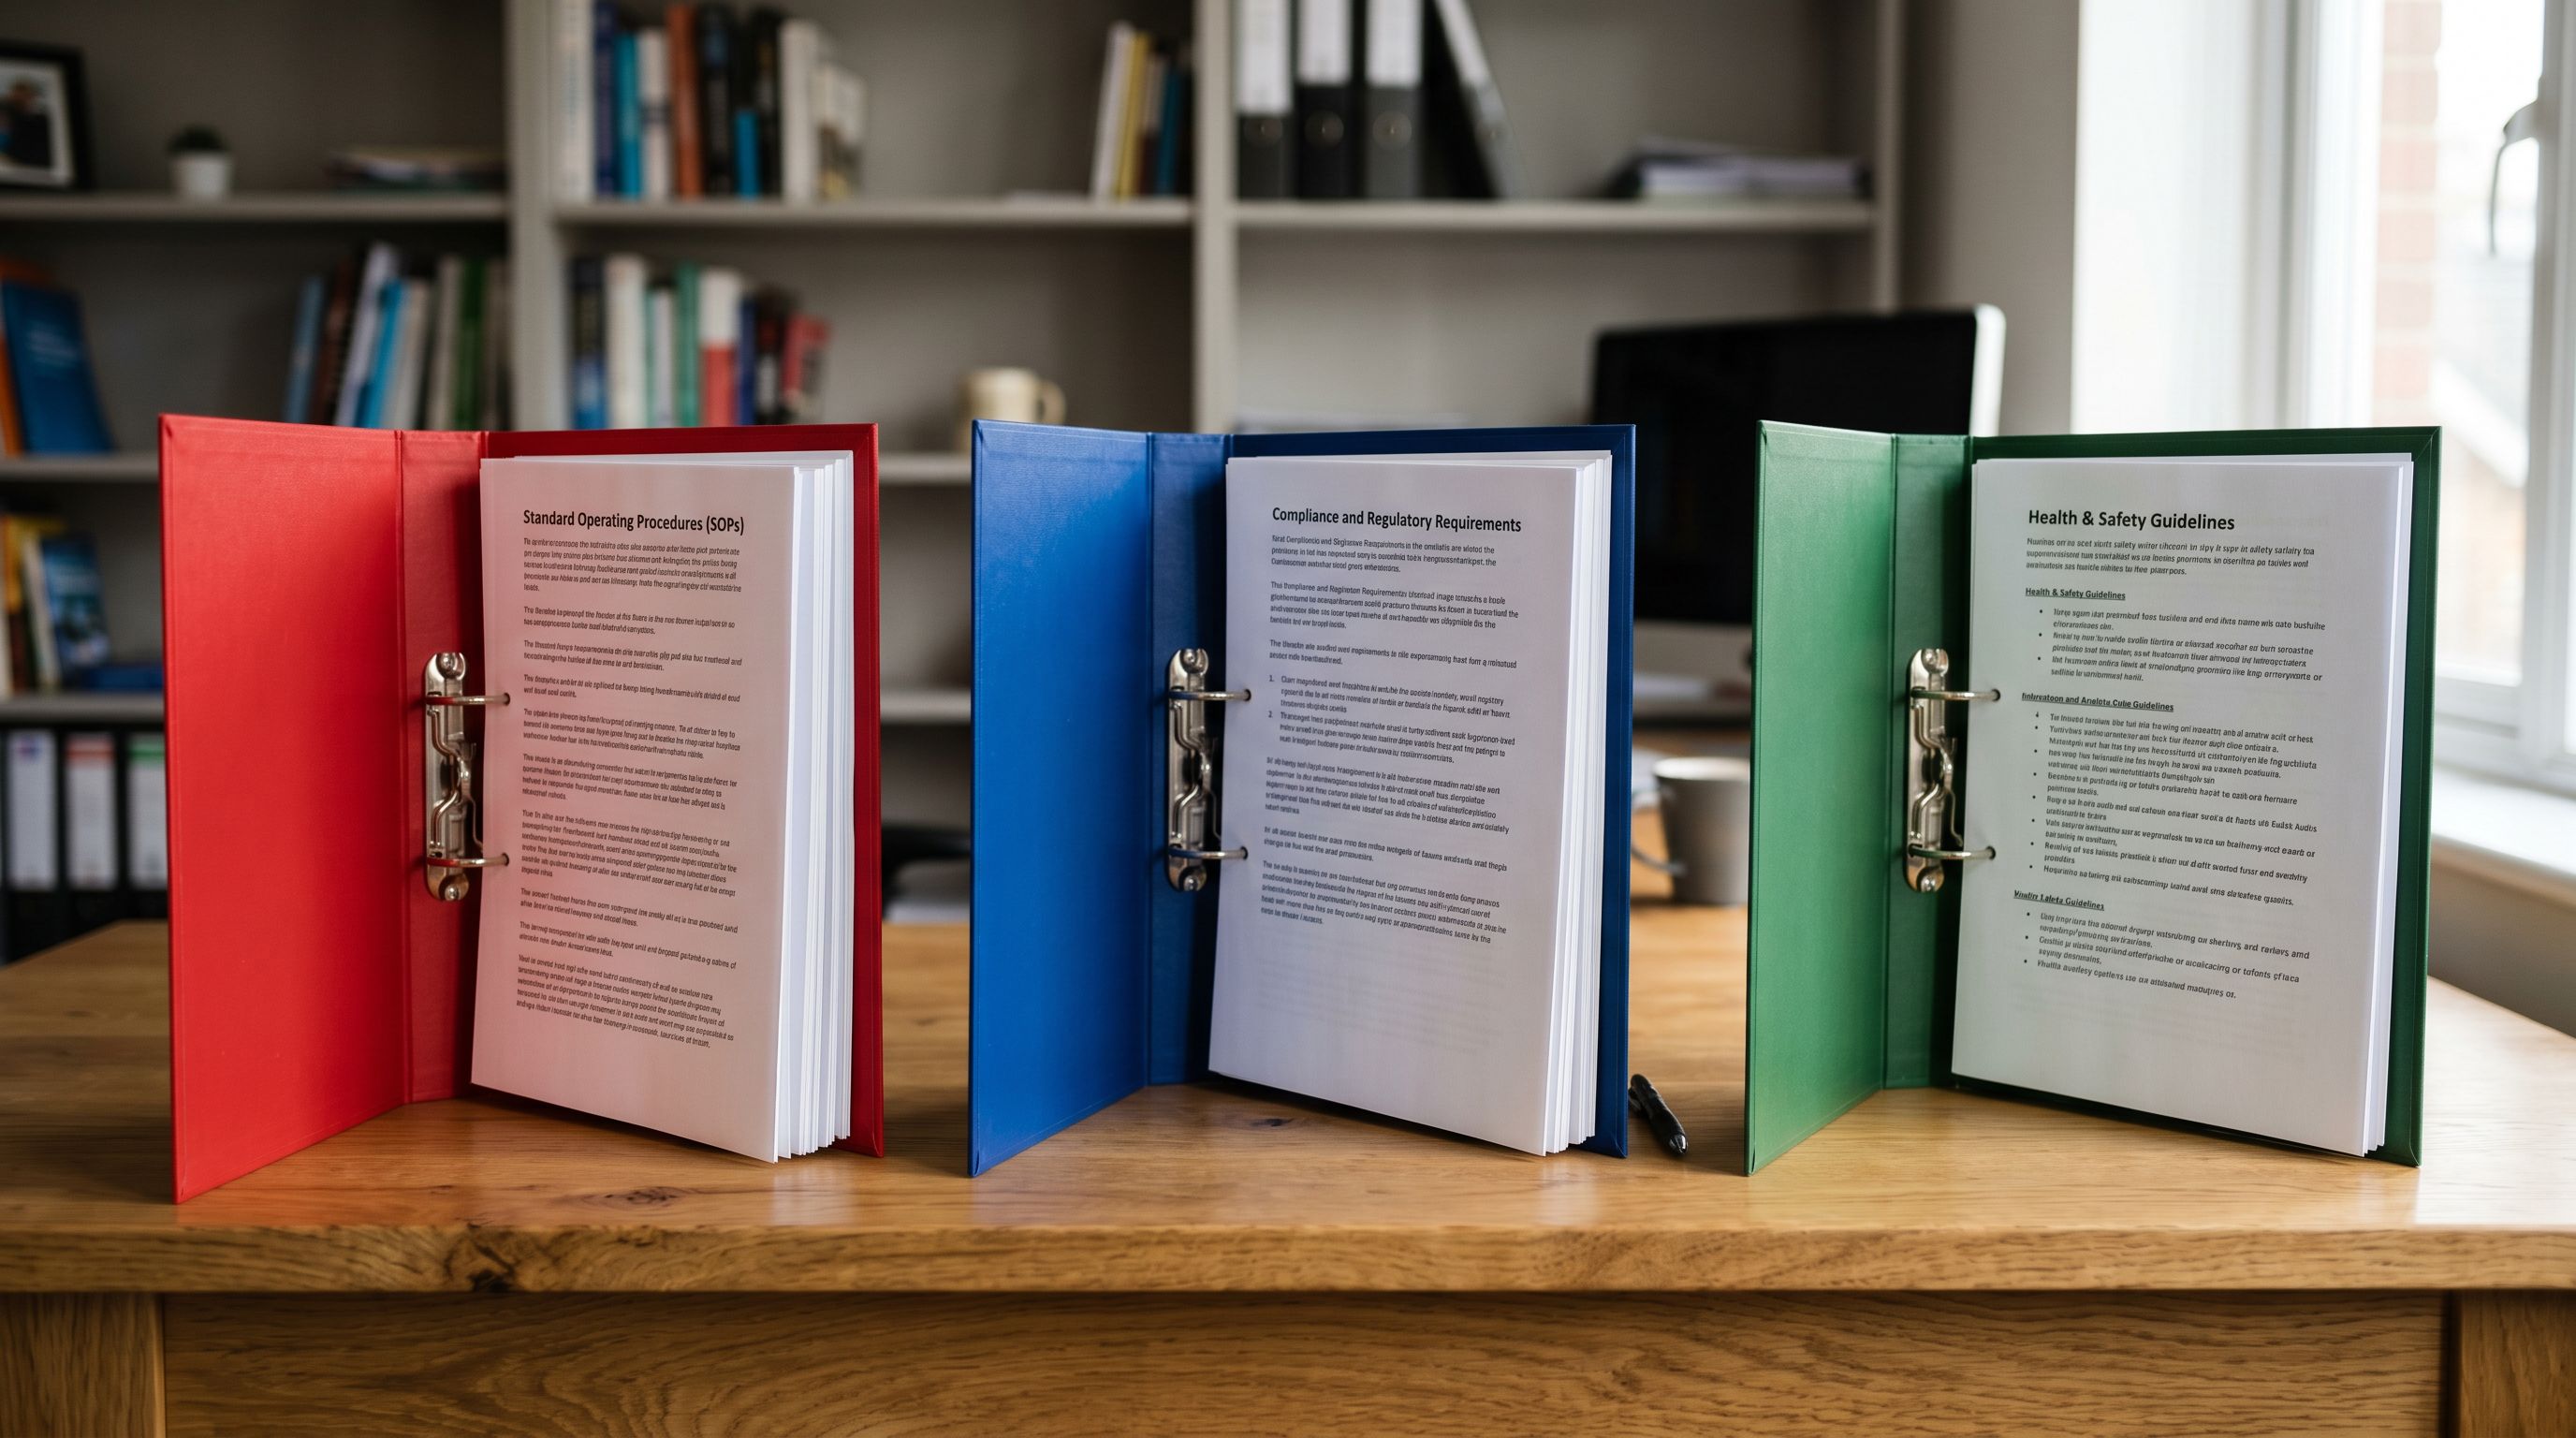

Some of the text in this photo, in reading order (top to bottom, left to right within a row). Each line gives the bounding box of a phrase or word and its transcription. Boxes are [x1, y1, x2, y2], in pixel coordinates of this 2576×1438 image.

[523, 509, 744, 536] Standard Operating Procedures (SOPs)
[1272, 506, 1521, 533] Compliance and Regulatory Requirements
[2028, 509, 2235, 531] Health & Safety Guidelines
[1412, 542, 1422, 550] the
[2025, 587, 2126, 599] Health & Safety Guidelines
[2132, 701, 2174, 712] Guidelines
[2065, 897, 2104, 910] Guidelines
